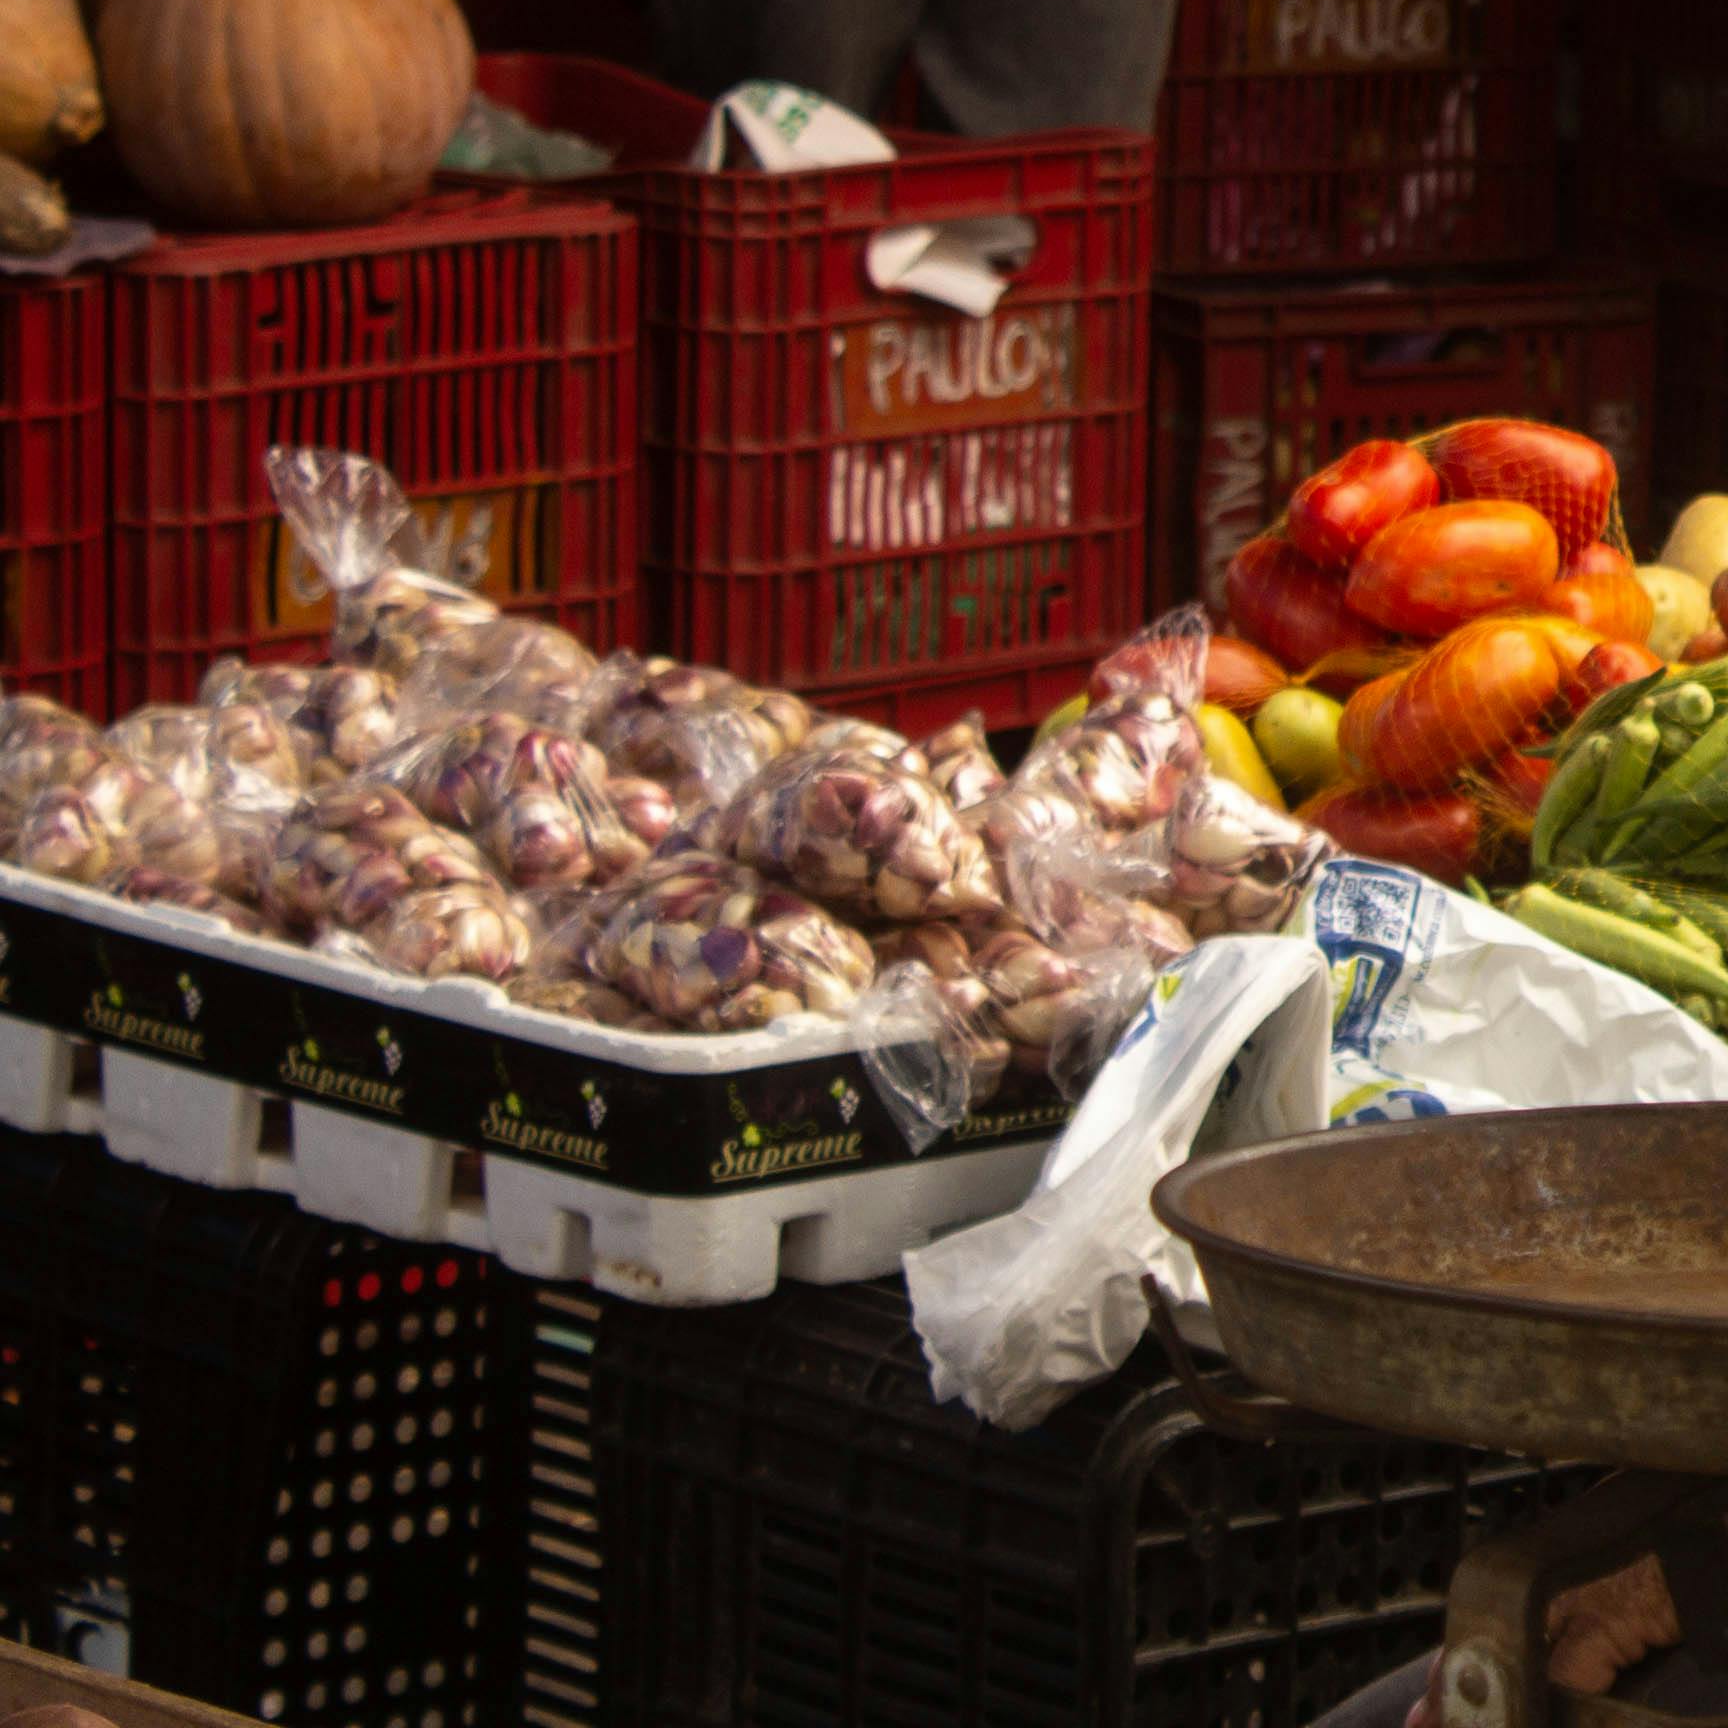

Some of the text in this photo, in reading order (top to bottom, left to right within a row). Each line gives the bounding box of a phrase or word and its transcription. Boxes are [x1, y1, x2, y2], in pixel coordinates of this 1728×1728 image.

[83, 989, 204, 1060] Supreme
[279, 1043, 404, 1112] Supreme
[481, 1100, 608, 1168] Supreme
[710, 1129, 863, 1182] Supreme
